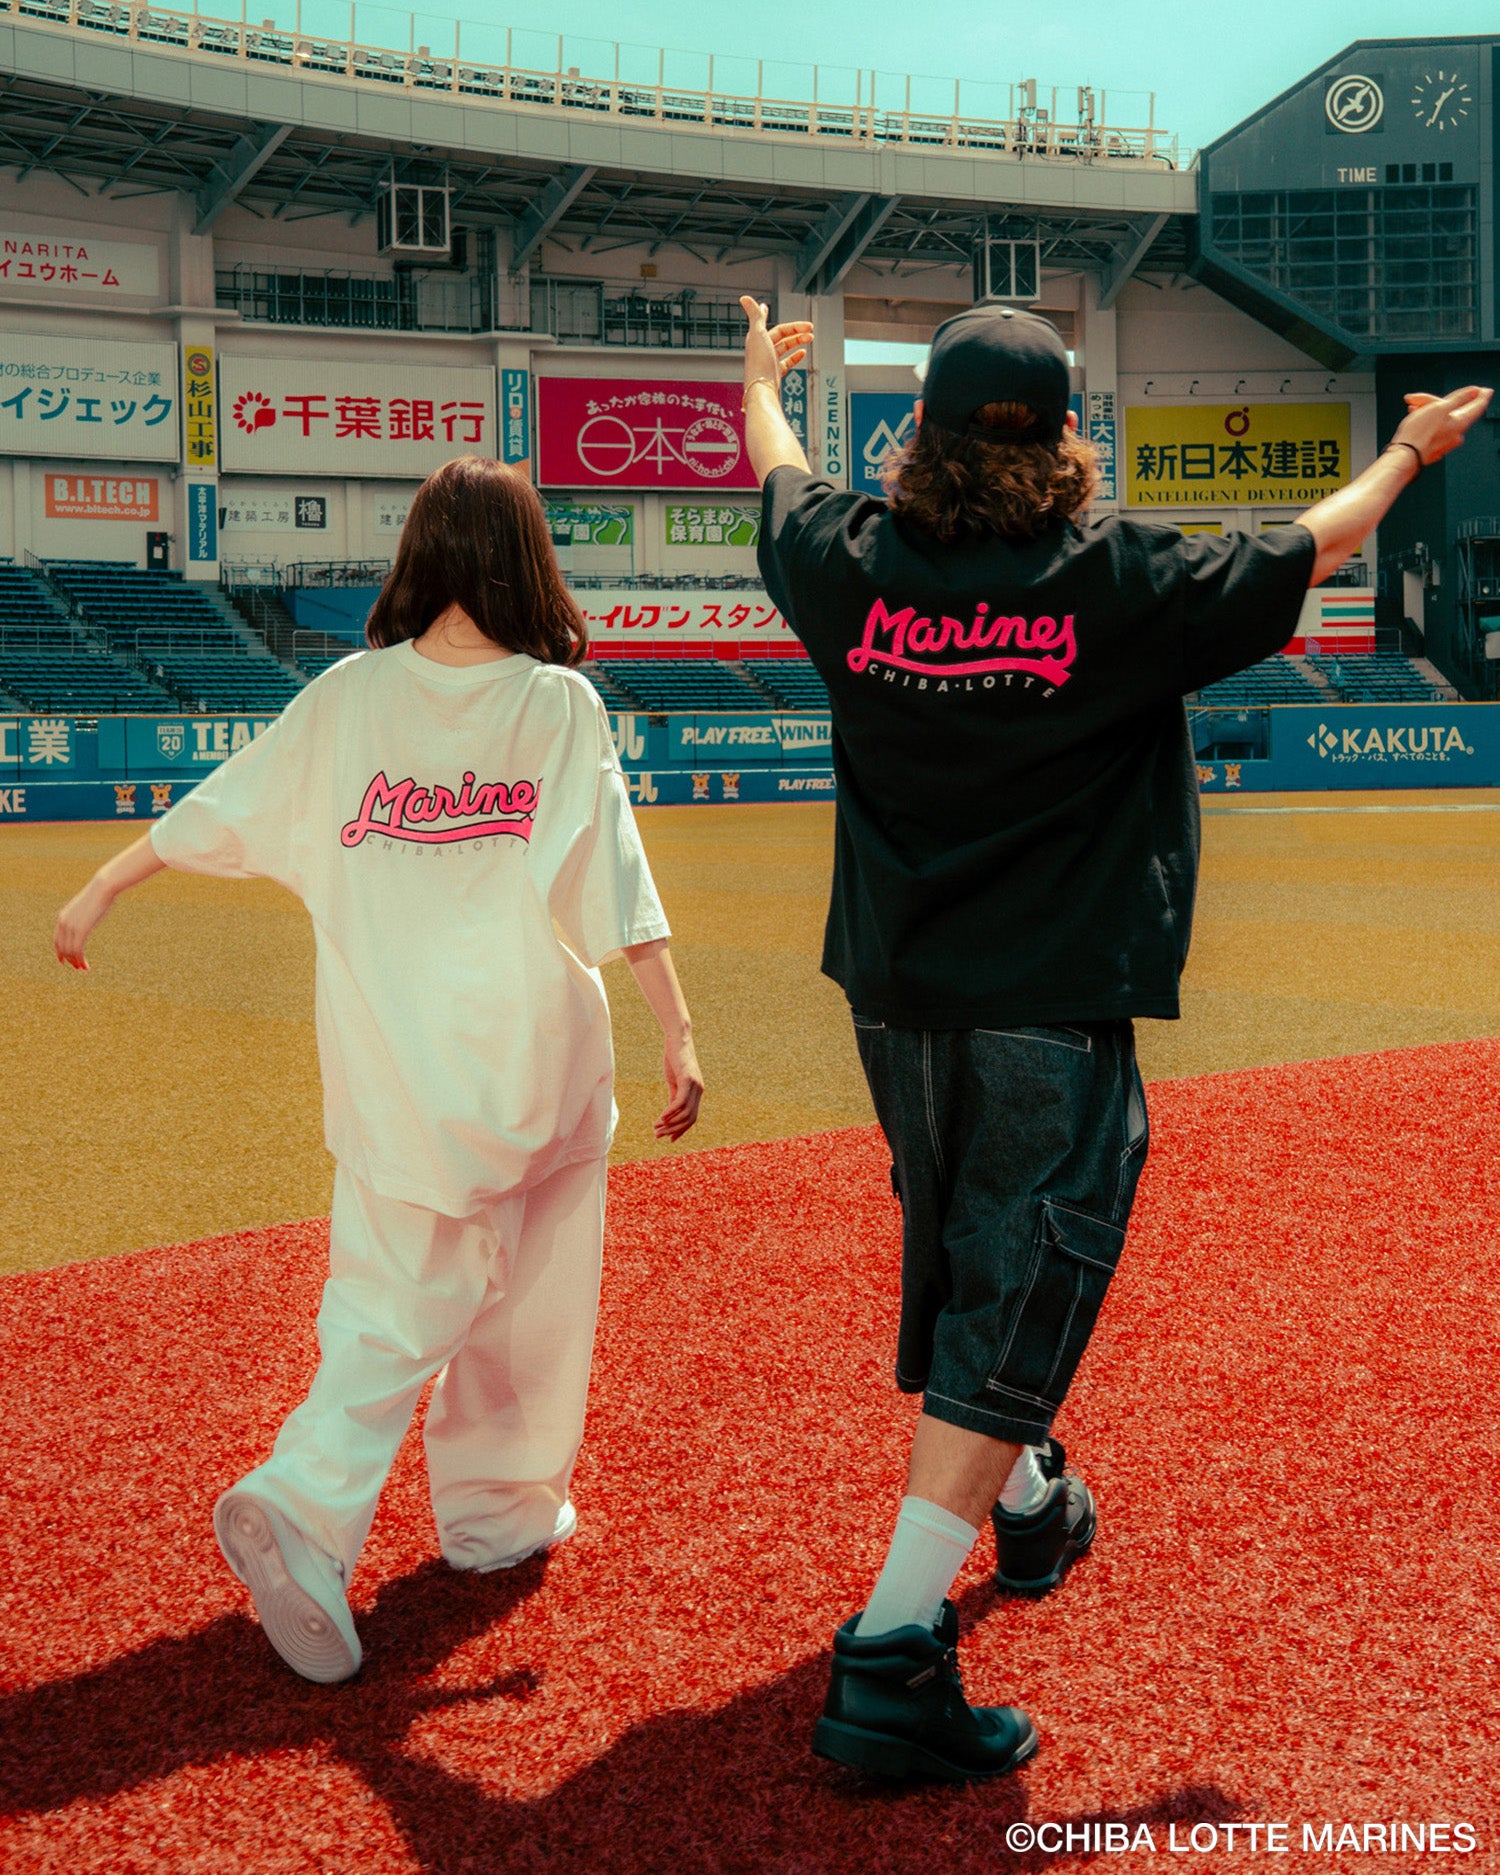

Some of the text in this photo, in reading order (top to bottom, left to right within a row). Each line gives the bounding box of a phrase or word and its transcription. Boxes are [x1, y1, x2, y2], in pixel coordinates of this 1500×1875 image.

[1338, 168, 1377, 183] TIME
[4, 240, 89, 260] NARITA
[0, 259, 120, 286] イユウホーム
[1, 386, 173, 427] イジェック
[508, 373, 524, 457] リロの賃貸
[187, 379, 214, 459] 杉山工事
[282, 395, 486, 443] 千葉銀行
[826, 392, 841, 475] ZENKO
[1136, 440, 1340, 481] 新日本建設
[54, 478, 151, 505] B.I.TECH
[1138, 489, 1239, 502] INTELLIGENT
[54, 504, 151, 517] www.bitech.co.jp
[227, 510, 290, 523] 建築工房
[670, 508, 735, 525] そらまめ
[670, 525, 723, 543] 保育園
[699, 604, 788, 630] スタン
[846, 598, 1077, 688] Marines
[161, 735, 181, 751] 20
[681, 727, 727, 745] PLAY
[727, 726, 777, 745] FREE.
[781, 726, 814, 741] WIN
[778, 779, 806, 791] PLAY
